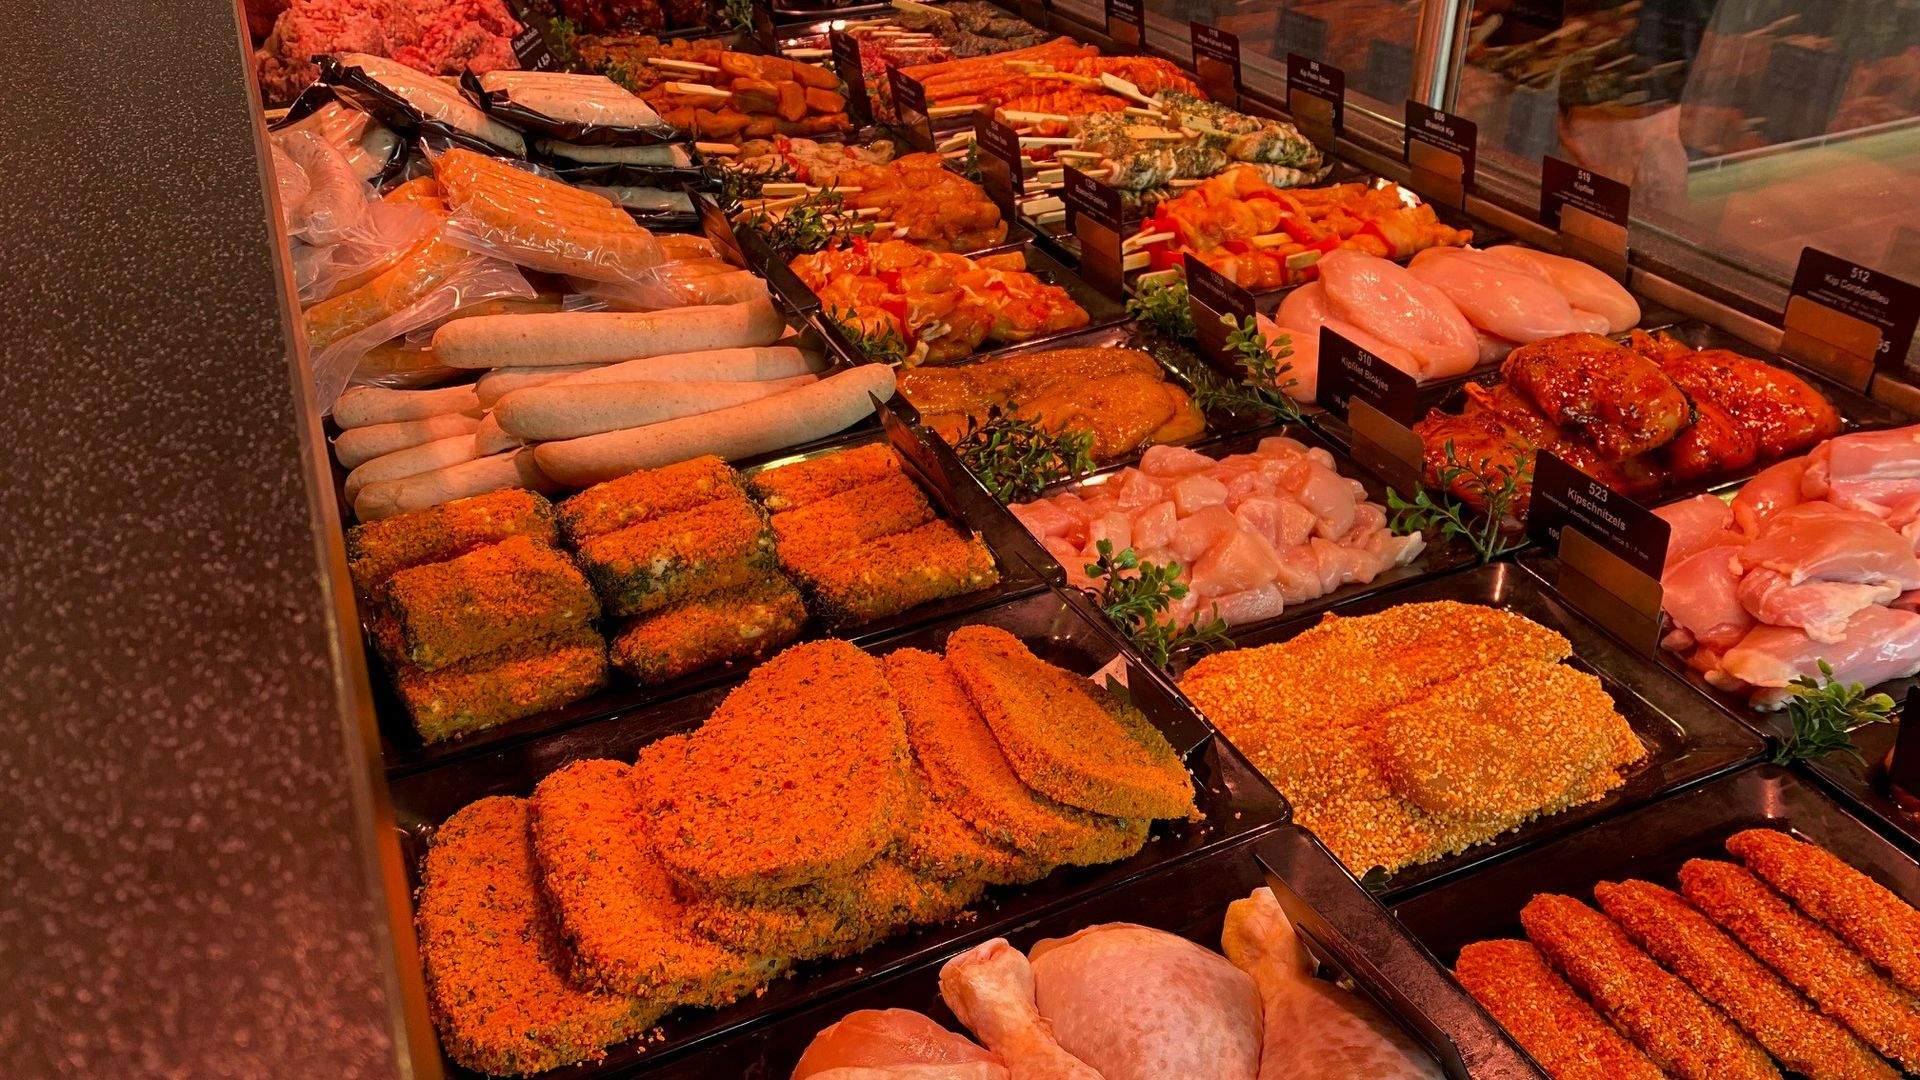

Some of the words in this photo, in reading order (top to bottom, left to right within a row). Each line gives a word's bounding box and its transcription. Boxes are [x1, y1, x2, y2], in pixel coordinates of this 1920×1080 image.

[1578, 170, 1591, 183] 519
[1824, 273, 1840, 287] Kip
[1850, 267, 1870, 283] 512
[1358, 350, 1372, 367] 510
[1341, 356, 1364, 377] Kipfilet
[1364, 369, 1389, 392] Blokjes
[1588, 482, 1608, 503] 523
[1567, 488, 1626, 531] Kipschnitzels
